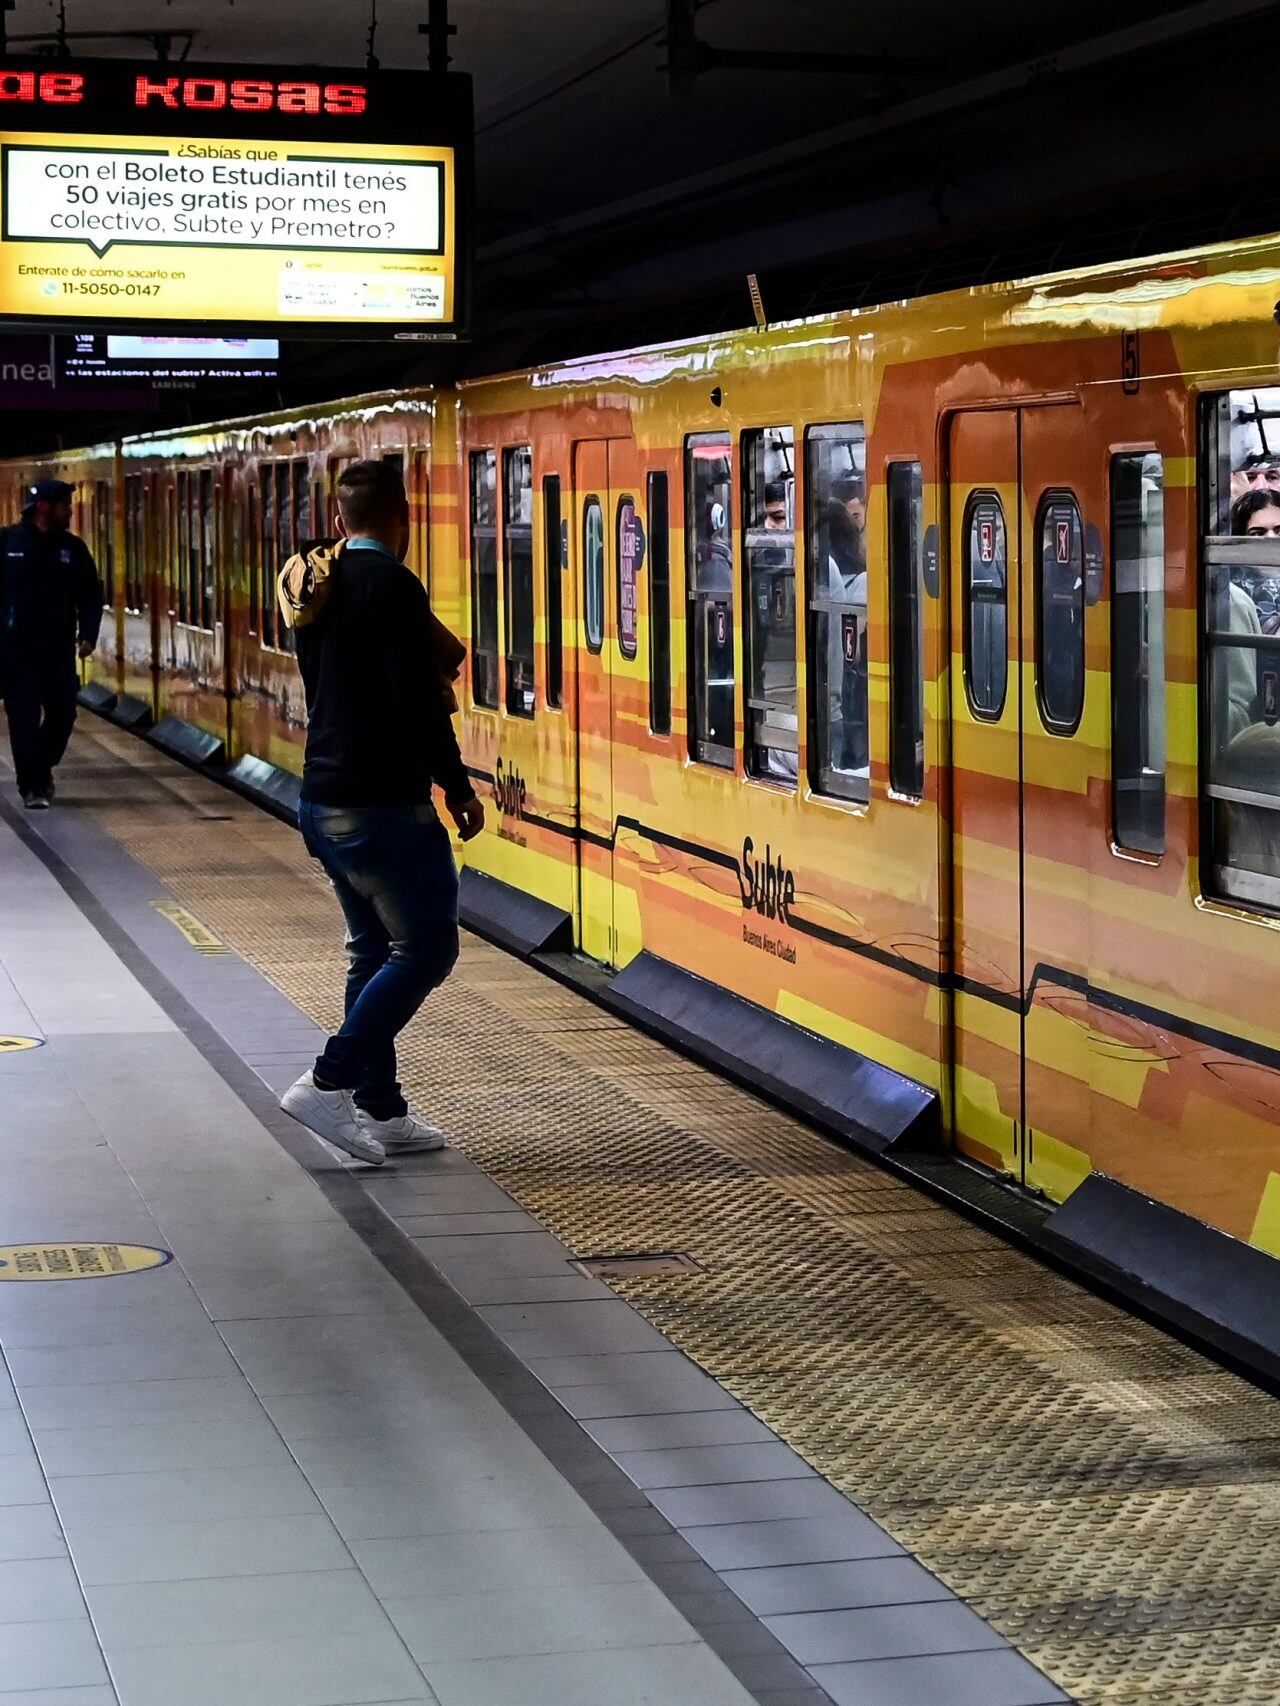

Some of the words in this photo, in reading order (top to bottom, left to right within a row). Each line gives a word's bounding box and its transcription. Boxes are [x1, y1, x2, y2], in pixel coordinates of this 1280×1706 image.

[177, 145, 241, 160] ¿Sabías
[246, 149, 278, 163] que
[45, 163, 89, 179] con
[97, 161, 116, 180] el
[125, 162, 204, 183] Boleto
[212, 166, 336, 187] Estudiantil
[344, 171, 407, 191] tenés
[66, 185, 99, 204] 50
[106, 186, 174, 209] viajes
[181, 190, 248, 212] gratis
[256, 196, 296, 213] por
[303, 199, 352, 214] mes
[358, 200, 386, 214] en
[51, 210, 166, 234] colectivo,
[174, 213, 243, 234] Subte
[250, 221, 264, 239] y
[271, 217, 395, 239] Premetro?
[18, 265, 68, 276] Enterate
[72, 267, 87, 277] de
[127, 269, 168, 280] sacarlo
[171, 271, 186, 280] en
[62, 282, 160, 296] 11-5050-0147
[95, 369, 150, 377] estaciones
[495, 756, 526, 819] Subte
[741, 836, 795, 925] Subte
